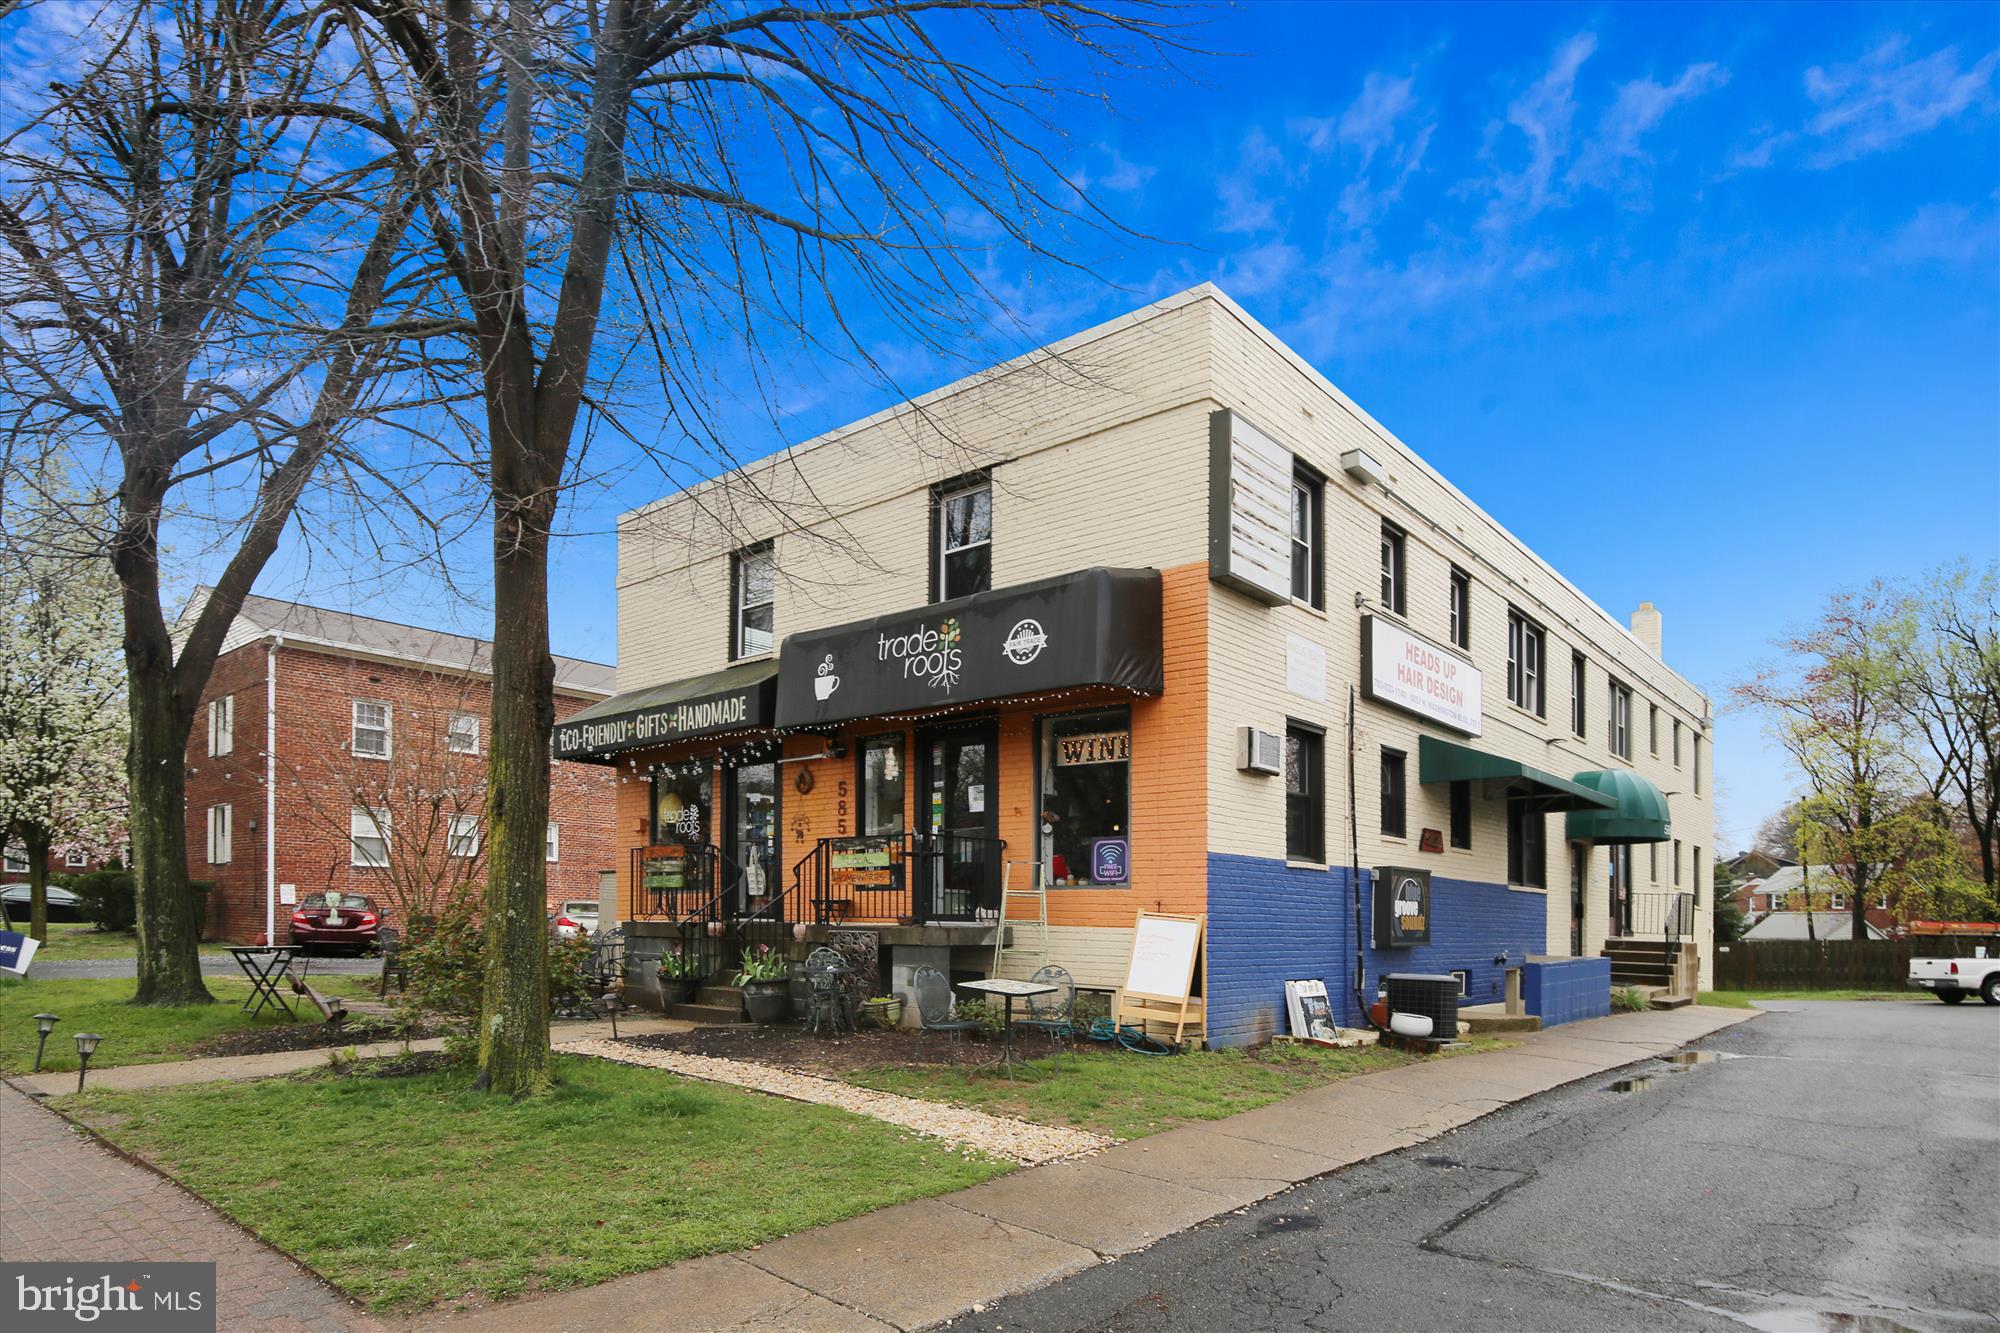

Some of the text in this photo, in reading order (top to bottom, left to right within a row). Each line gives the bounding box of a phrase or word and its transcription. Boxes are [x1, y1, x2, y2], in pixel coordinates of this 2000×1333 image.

[878, 624, 938, 661] trade
[1405, 641, 1457, 681] HEADS UP
[904, 646, 962, 690] roots
[1396, 662, 1464, 707] HAIR DESIGN
[559, 695, 746, 752] ECO-FRIENDLY GIFTS HANDMADE
[664, 804, 689, 823] trade
[676, 820, 701, 838] roots
[1394, 899, 1419, 918] groove
